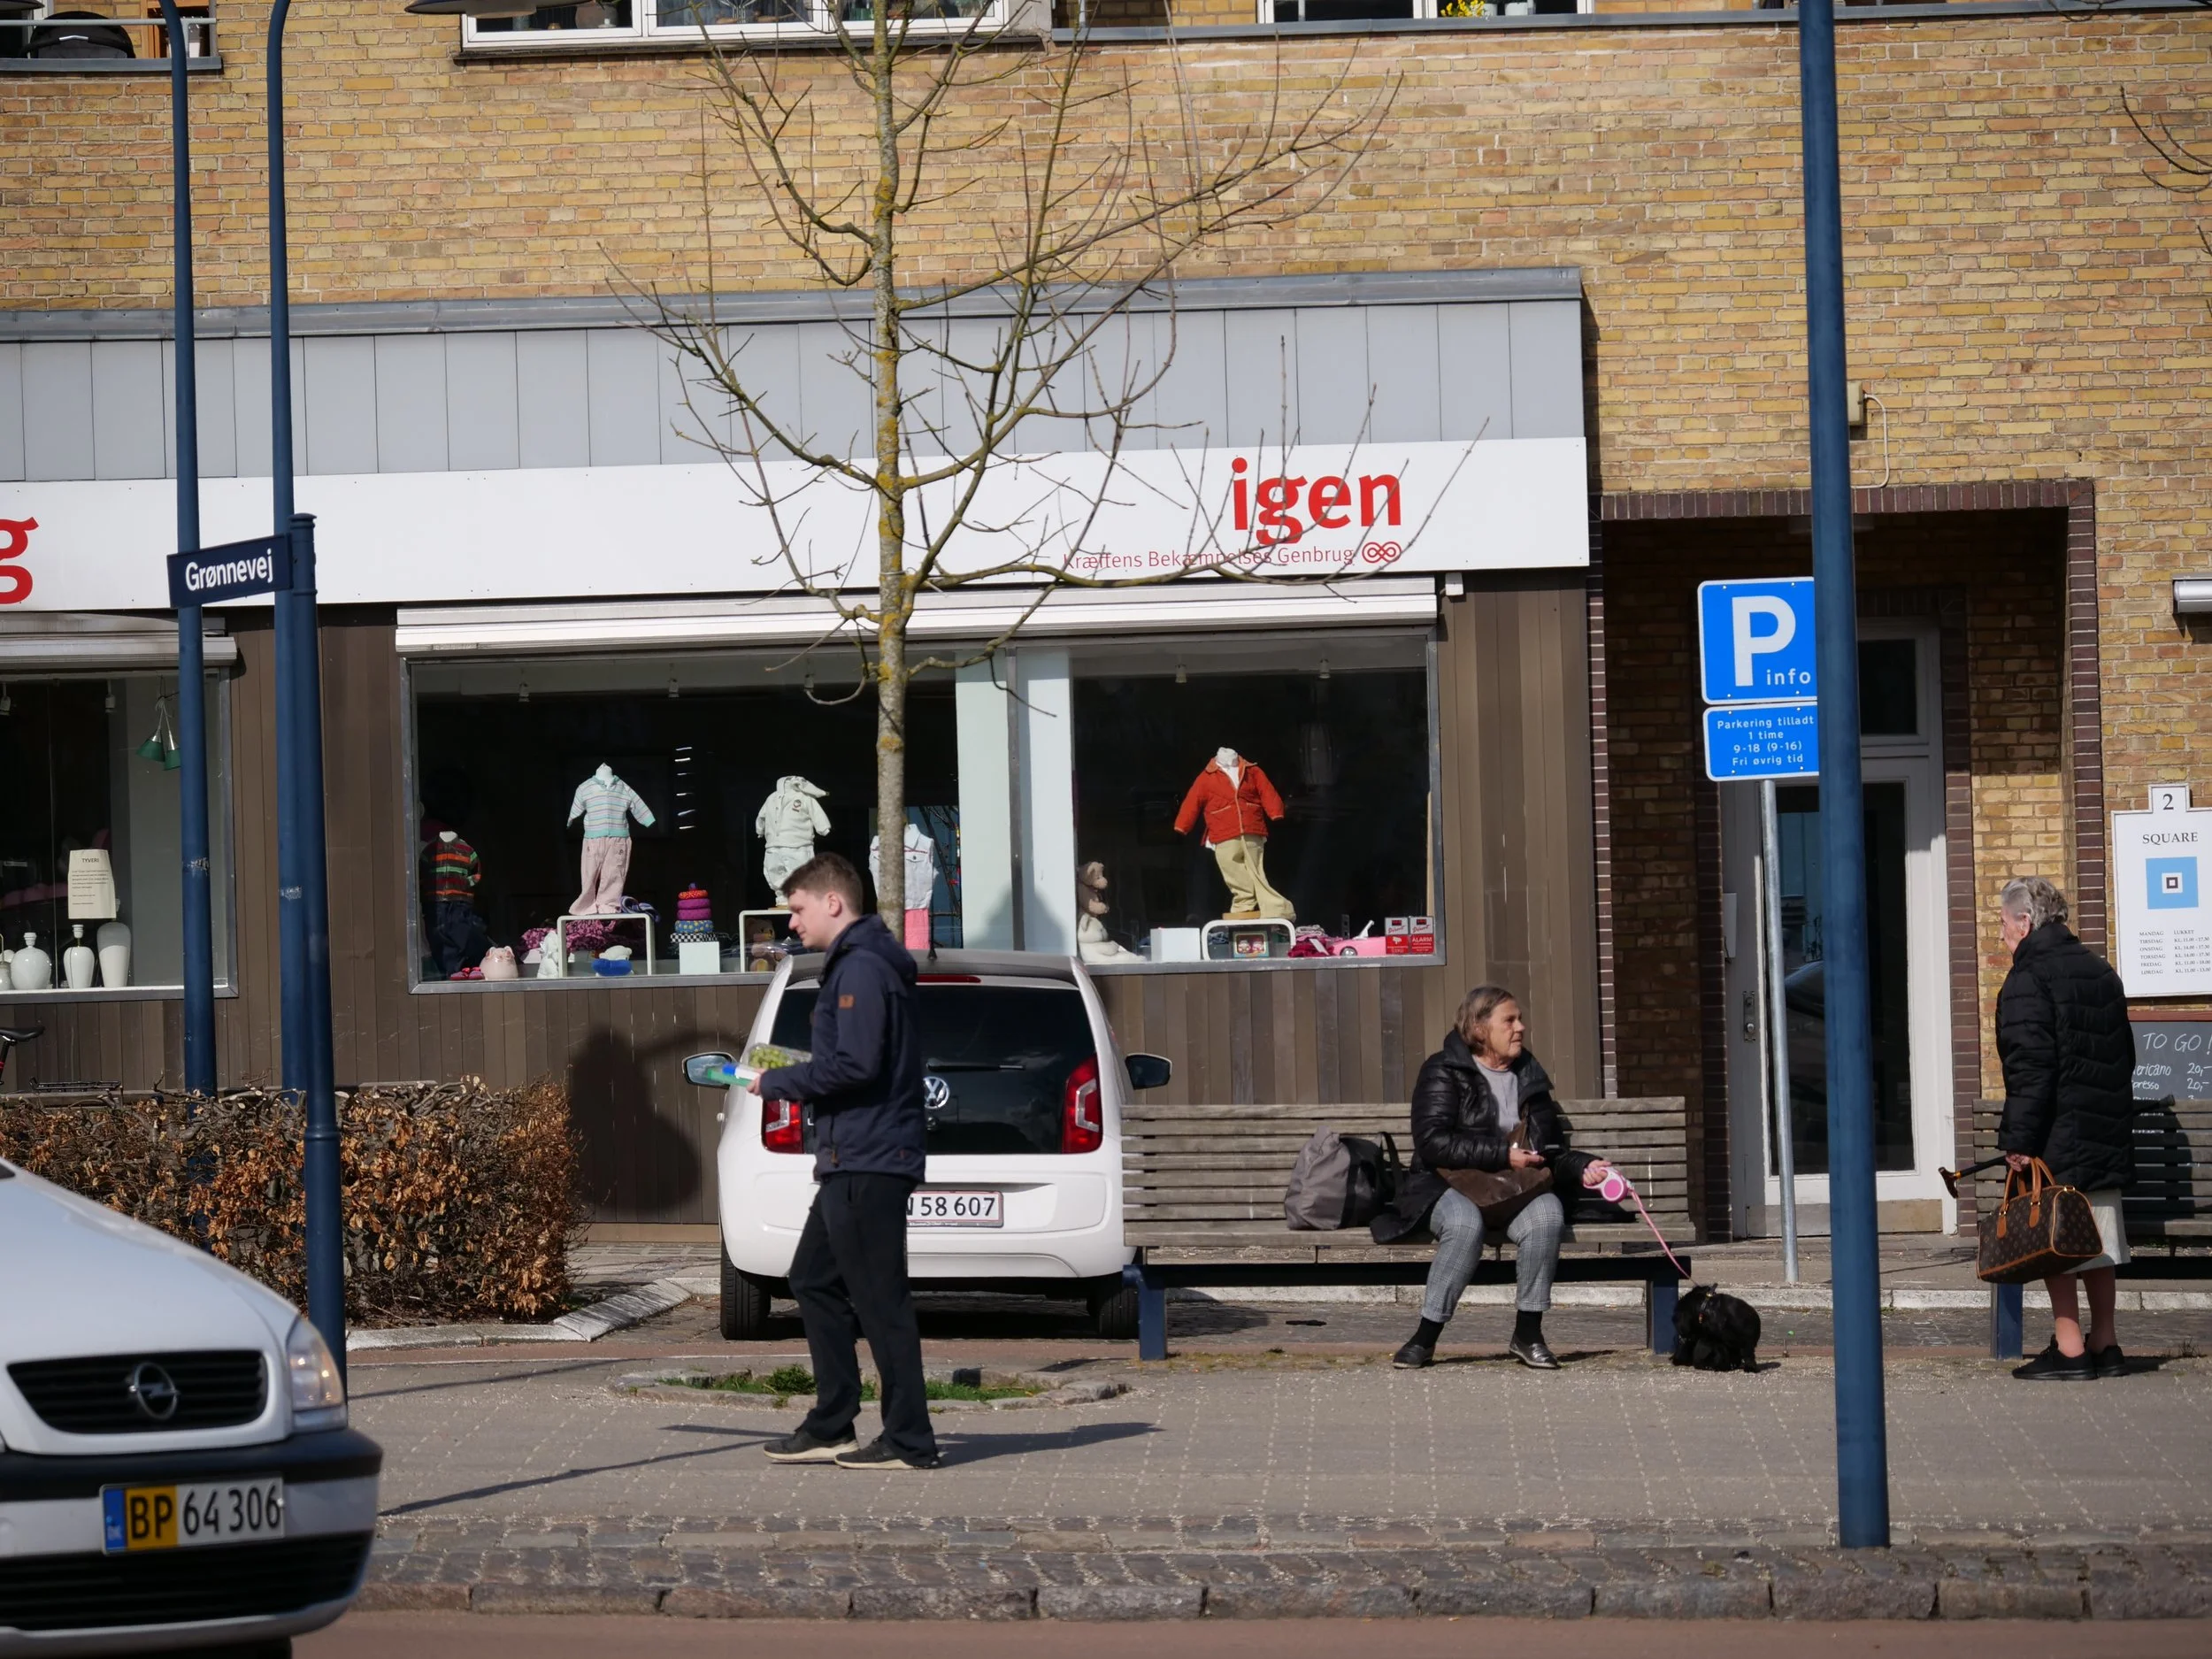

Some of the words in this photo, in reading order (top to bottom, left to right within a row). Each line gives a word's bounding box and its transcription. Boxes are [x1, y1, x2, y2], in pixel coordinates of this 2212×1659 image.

[1232, 457, 1402, 545] igen
[1063, 551, 1142, 570] Kræftens
[1278, 546, 1355, 566] Genbrug
[185, 548, 273, 591] Grønnevej
[1732, 595, 1796, 687] P
[1766, 668, 1811, 686] info
[1717, 718, 1772, 729] Parkering
[1778, 716, 1814, 726] tilladt
[1759, 730, 1784, 740] time
[1732, 757, 1747, 766] Fri
[1753, 756, 1782, 765] øvrig
[1787, 754, 1803, 764] tid
[2162, 793, 2174, 810] 2
[2142, 832, 2199, 845] SQUARE
[2143, 1033, 2168, 1050] TO
[2174, 1033, 2201, 1053] GO
[2131, 1080, 2159, 1091] presso
[130, 1495, 173, 1539] BP
